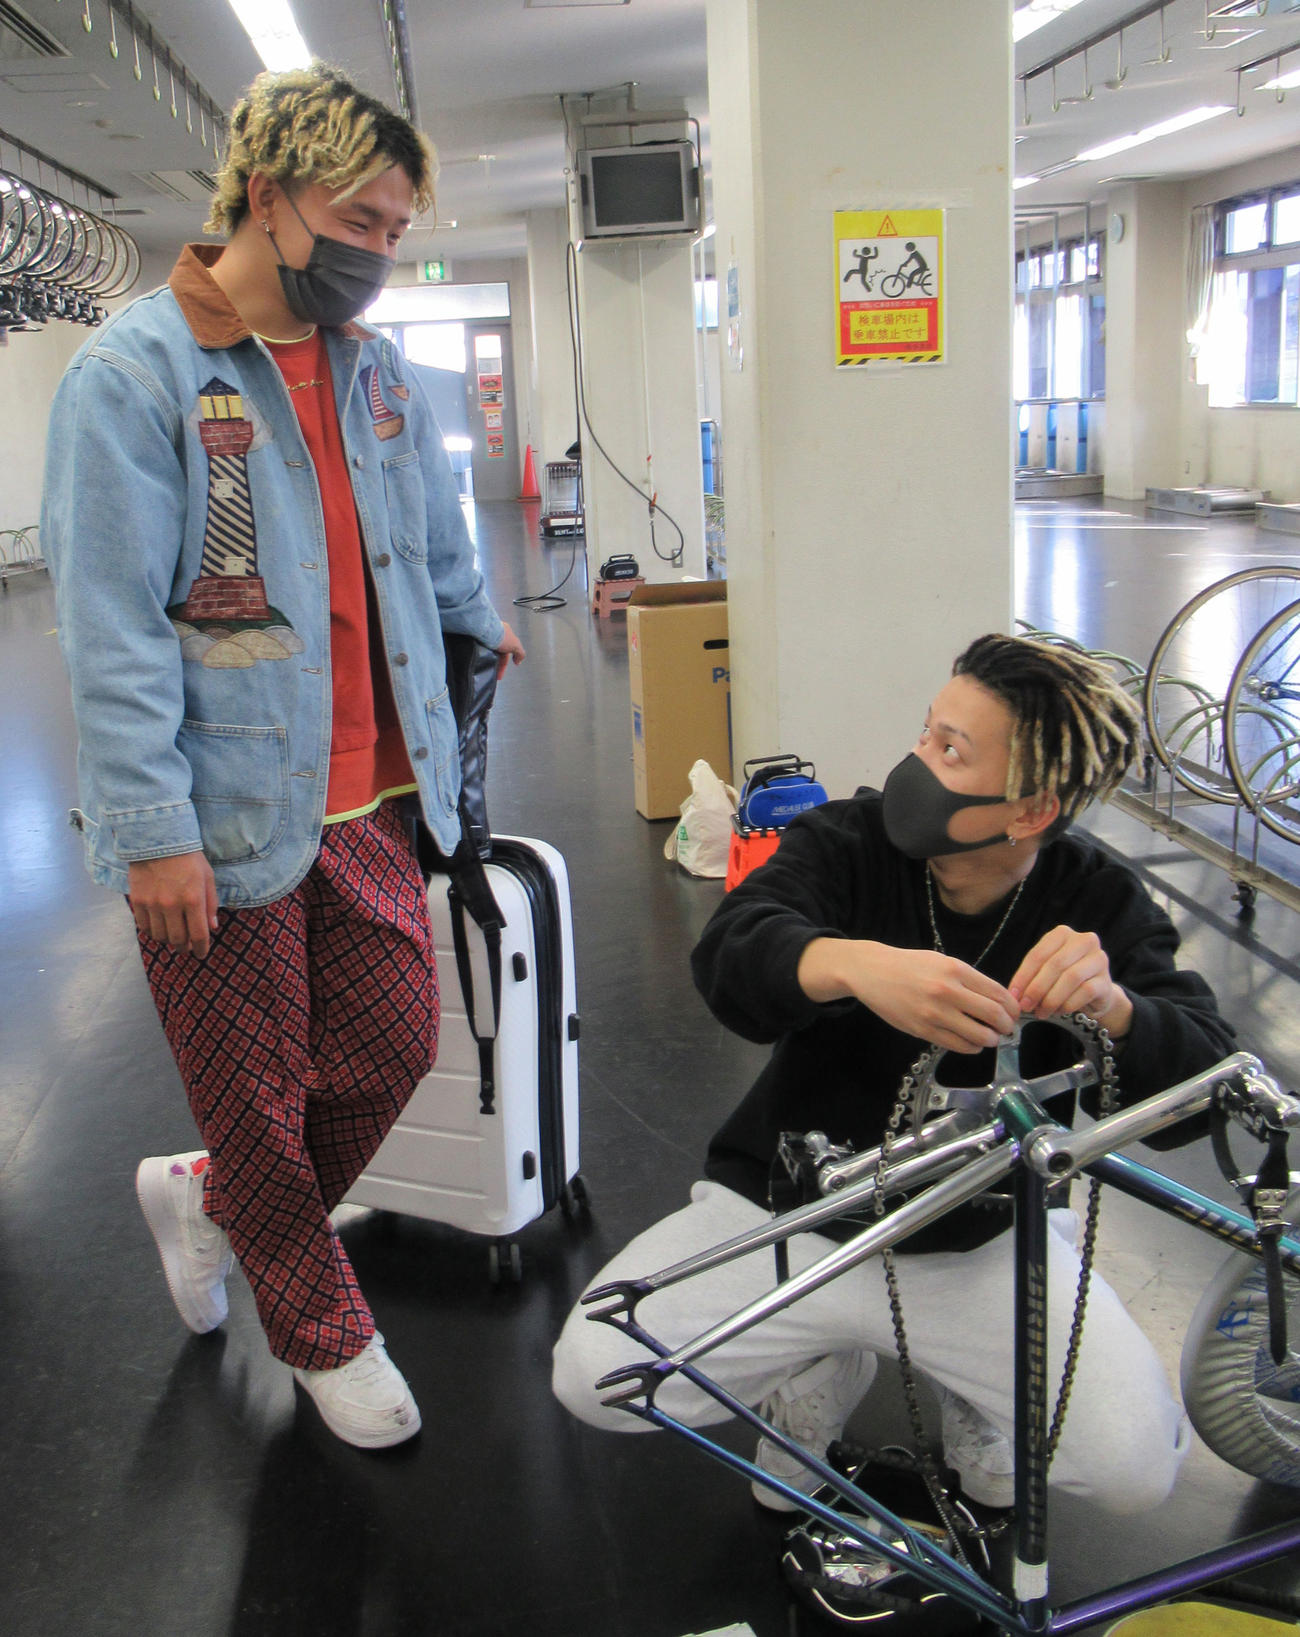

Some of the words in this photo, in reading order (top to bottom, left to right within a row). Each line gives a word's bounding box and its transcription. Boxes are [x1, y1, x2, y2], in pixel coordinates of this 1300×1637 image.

[854, 327, 926, 340] 乗車禁止です
